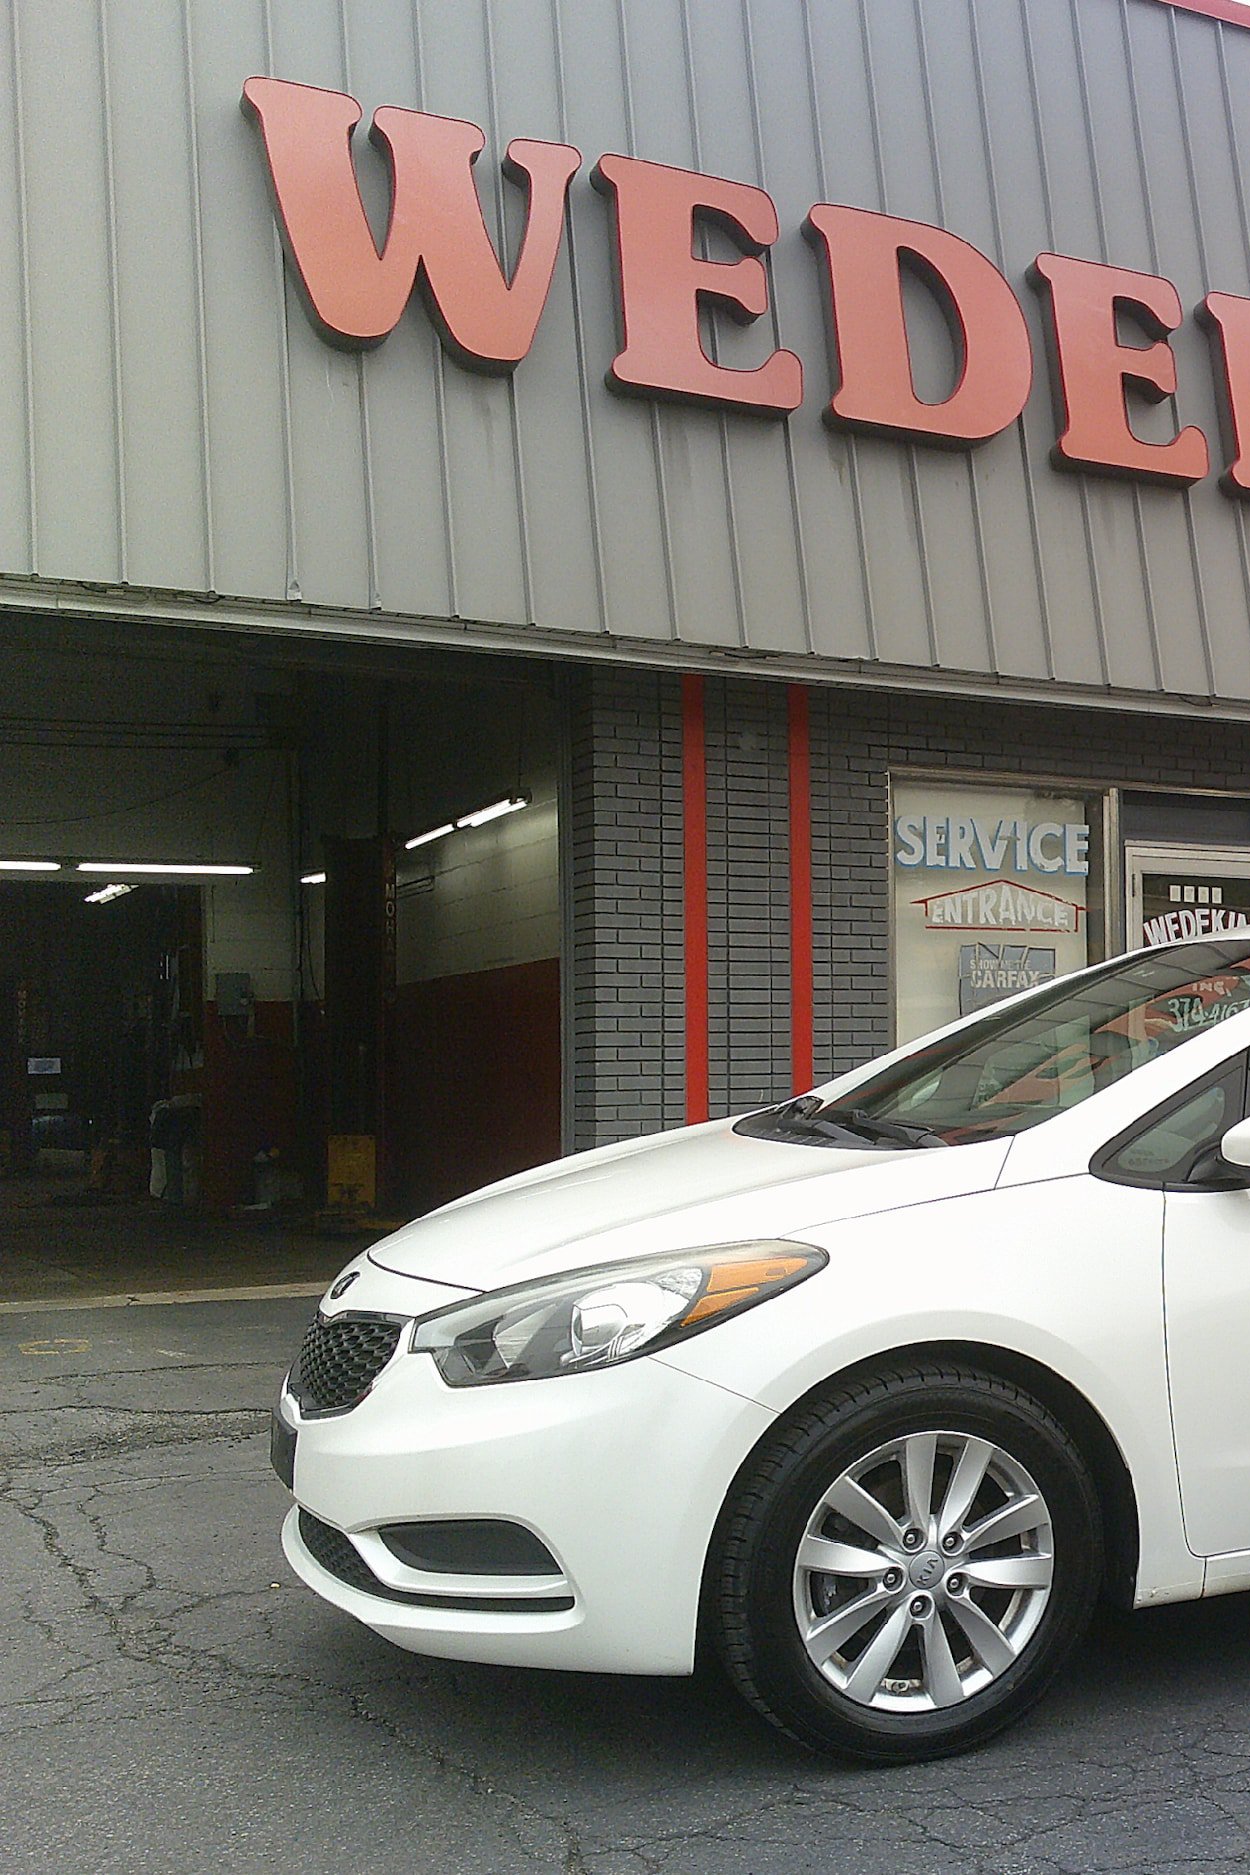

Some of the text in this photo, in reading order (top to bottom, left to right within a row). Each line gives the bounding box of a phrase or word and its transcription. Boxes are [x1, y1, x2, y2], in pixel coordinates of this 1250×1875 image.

[895, 815, 1090, 876] SERVICE
[931, 886, 1069, 927] ENTRANCE
[970, 970, 1040, 988] CARFAX
[916, 1558, 939, 1586] KIA
